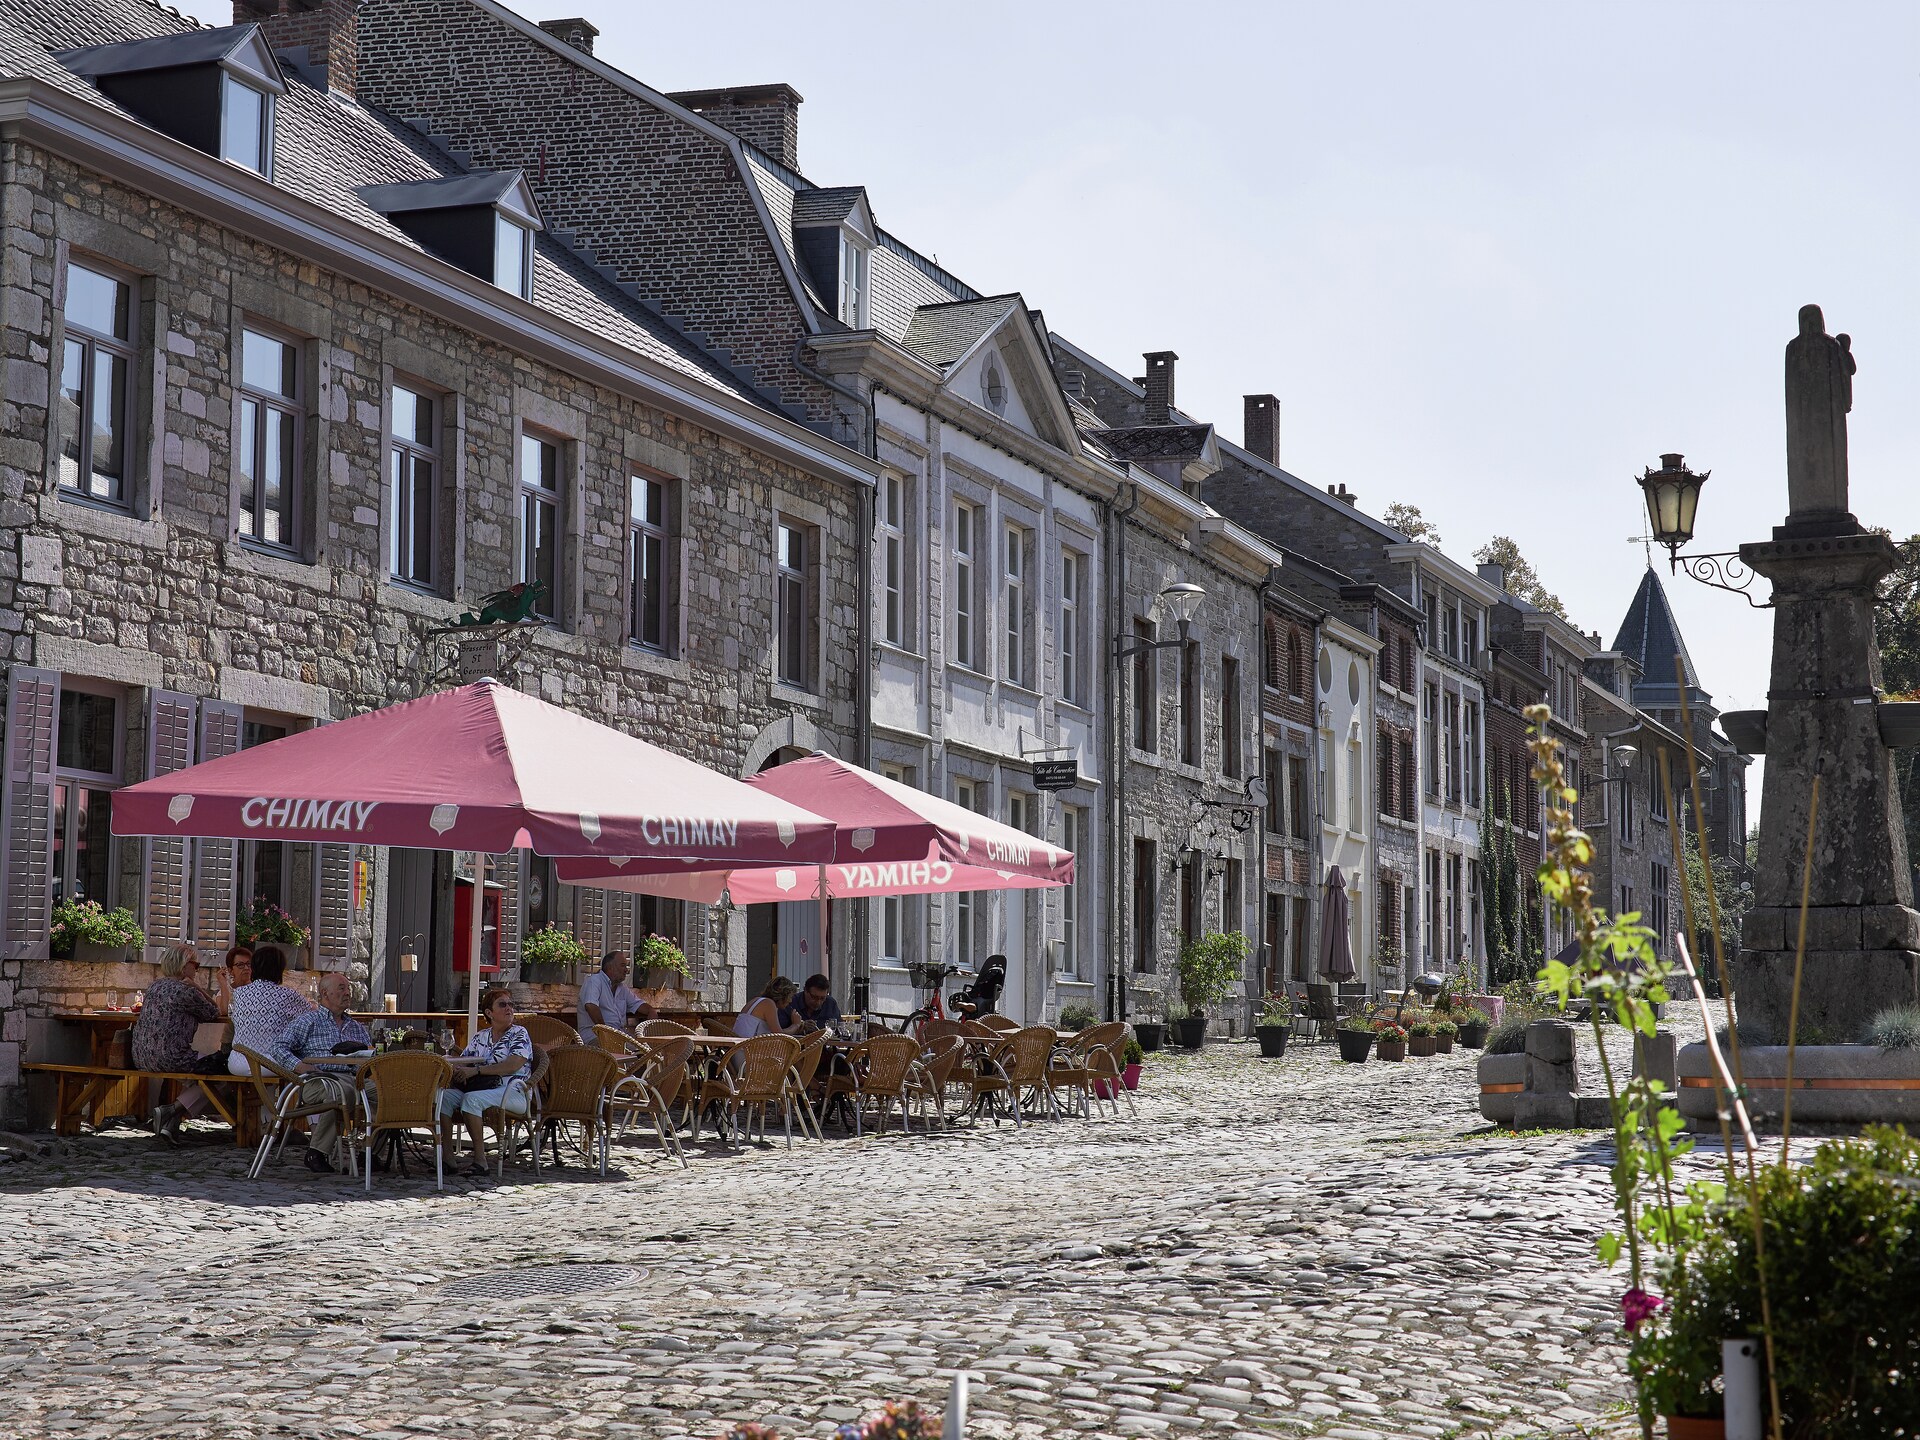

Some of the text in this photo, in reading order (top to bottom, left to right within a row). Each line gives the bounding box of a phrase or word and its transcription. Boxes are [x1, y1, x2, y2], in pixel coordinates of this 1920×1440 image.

[461, 643, 493, 652] Brasserie
[463, 666, 492, 675] Georges
[241, 797, 380, 831] CHIMAY
[641, 814, 738, 846] CHIMAY
[986, 838, 1031, 866] CHIMAY
